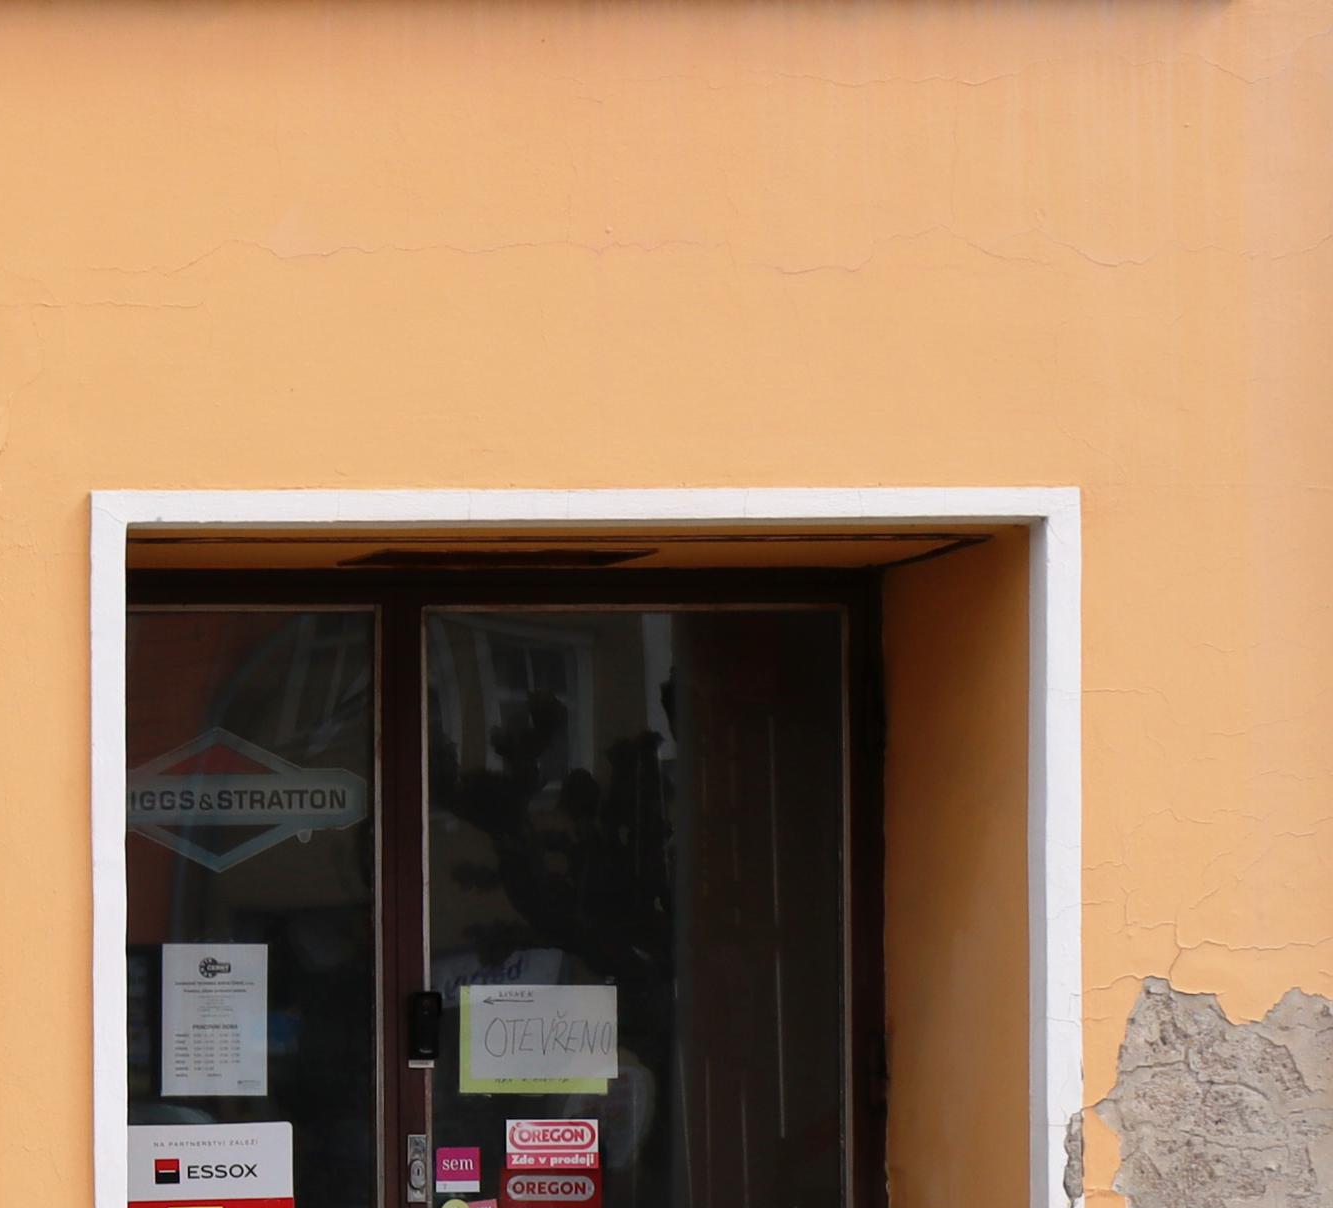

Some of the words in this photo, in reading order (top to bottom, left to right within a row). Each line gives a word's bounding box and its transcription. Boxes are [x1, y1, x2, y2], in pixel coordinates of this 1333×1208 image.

[129, 789, 195, 811] IGGS
[217, 789, 346, 810] STRATTON
[484, 1008, 613, 1058] OTEVŘENO
[518, 1127, 586, 1143] OREGON
[442, 1158, 474, 1171] sem
[511, 1154, 536, 1165] Zde
[538, 1156, 548, 1164] v
[550, 1153, 596, 1167] prodeji
[187, 1163, 258, 1179] ESSOX
[512, 1181, 586, 1195] OREGON
